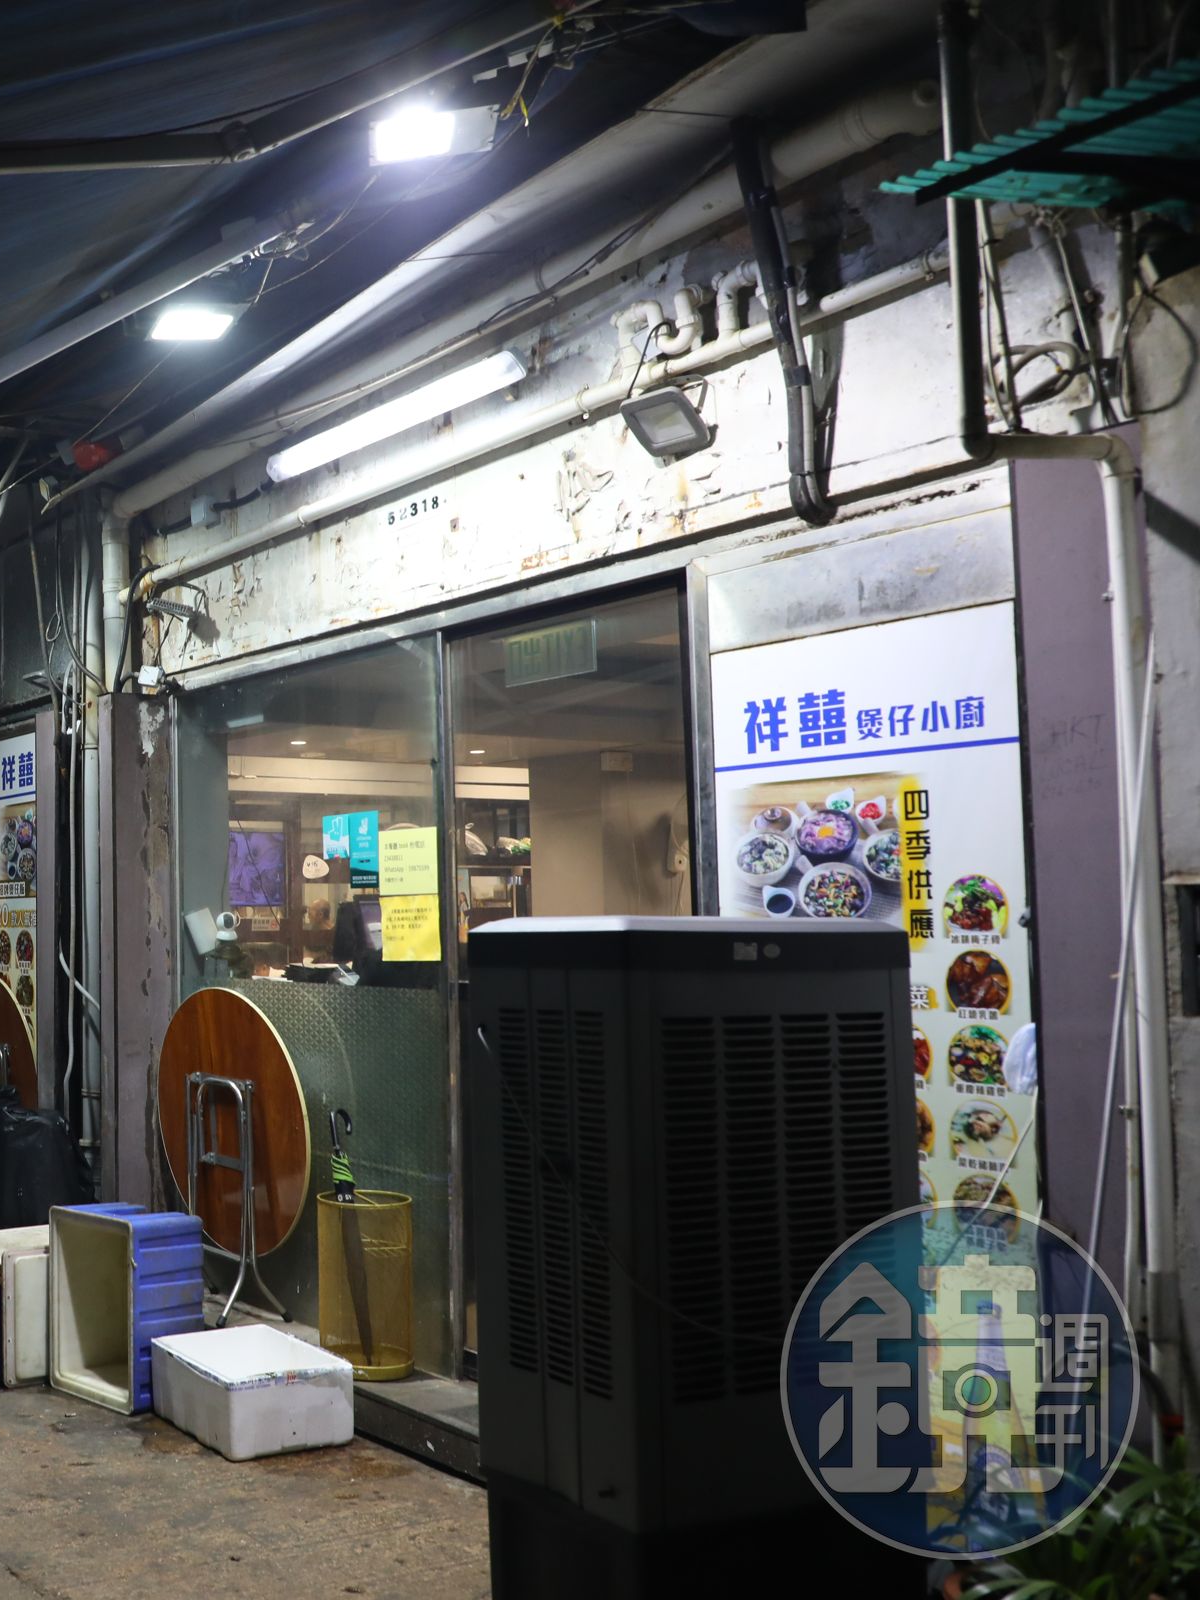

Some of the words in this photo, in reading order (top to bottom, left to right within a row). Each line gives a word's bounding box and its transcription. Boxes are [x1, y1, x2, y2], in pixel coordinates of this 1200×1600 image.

[387, 496, 439, 526] 52318
[856, 696, 986, 741] 煲仔小廚
[904, 788, 934, 939] 四季供應
